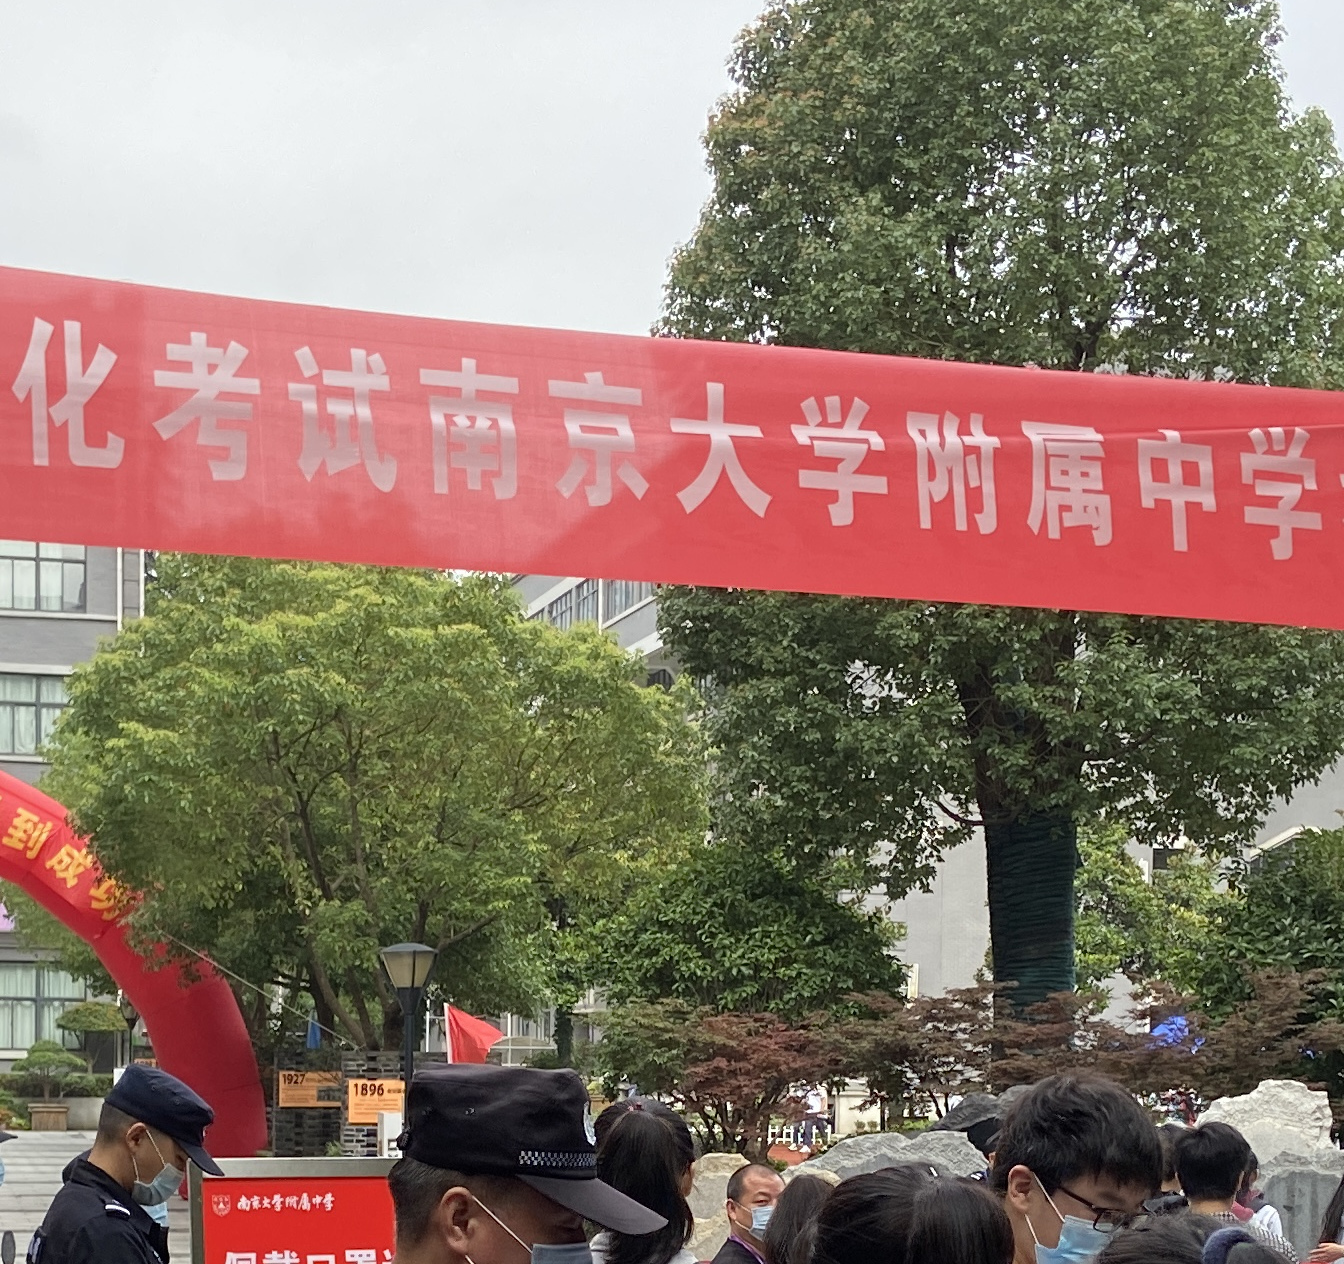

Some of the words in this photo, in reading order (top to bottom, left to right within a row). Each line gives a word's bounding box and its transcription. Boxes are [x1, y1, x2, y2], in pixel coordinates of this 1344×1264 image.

[282, 1073, 306, 1085] 1927
[353, 1083, 385, 1097] 1896
[236, 1192, 336, 1213] 南京大学附属中学
